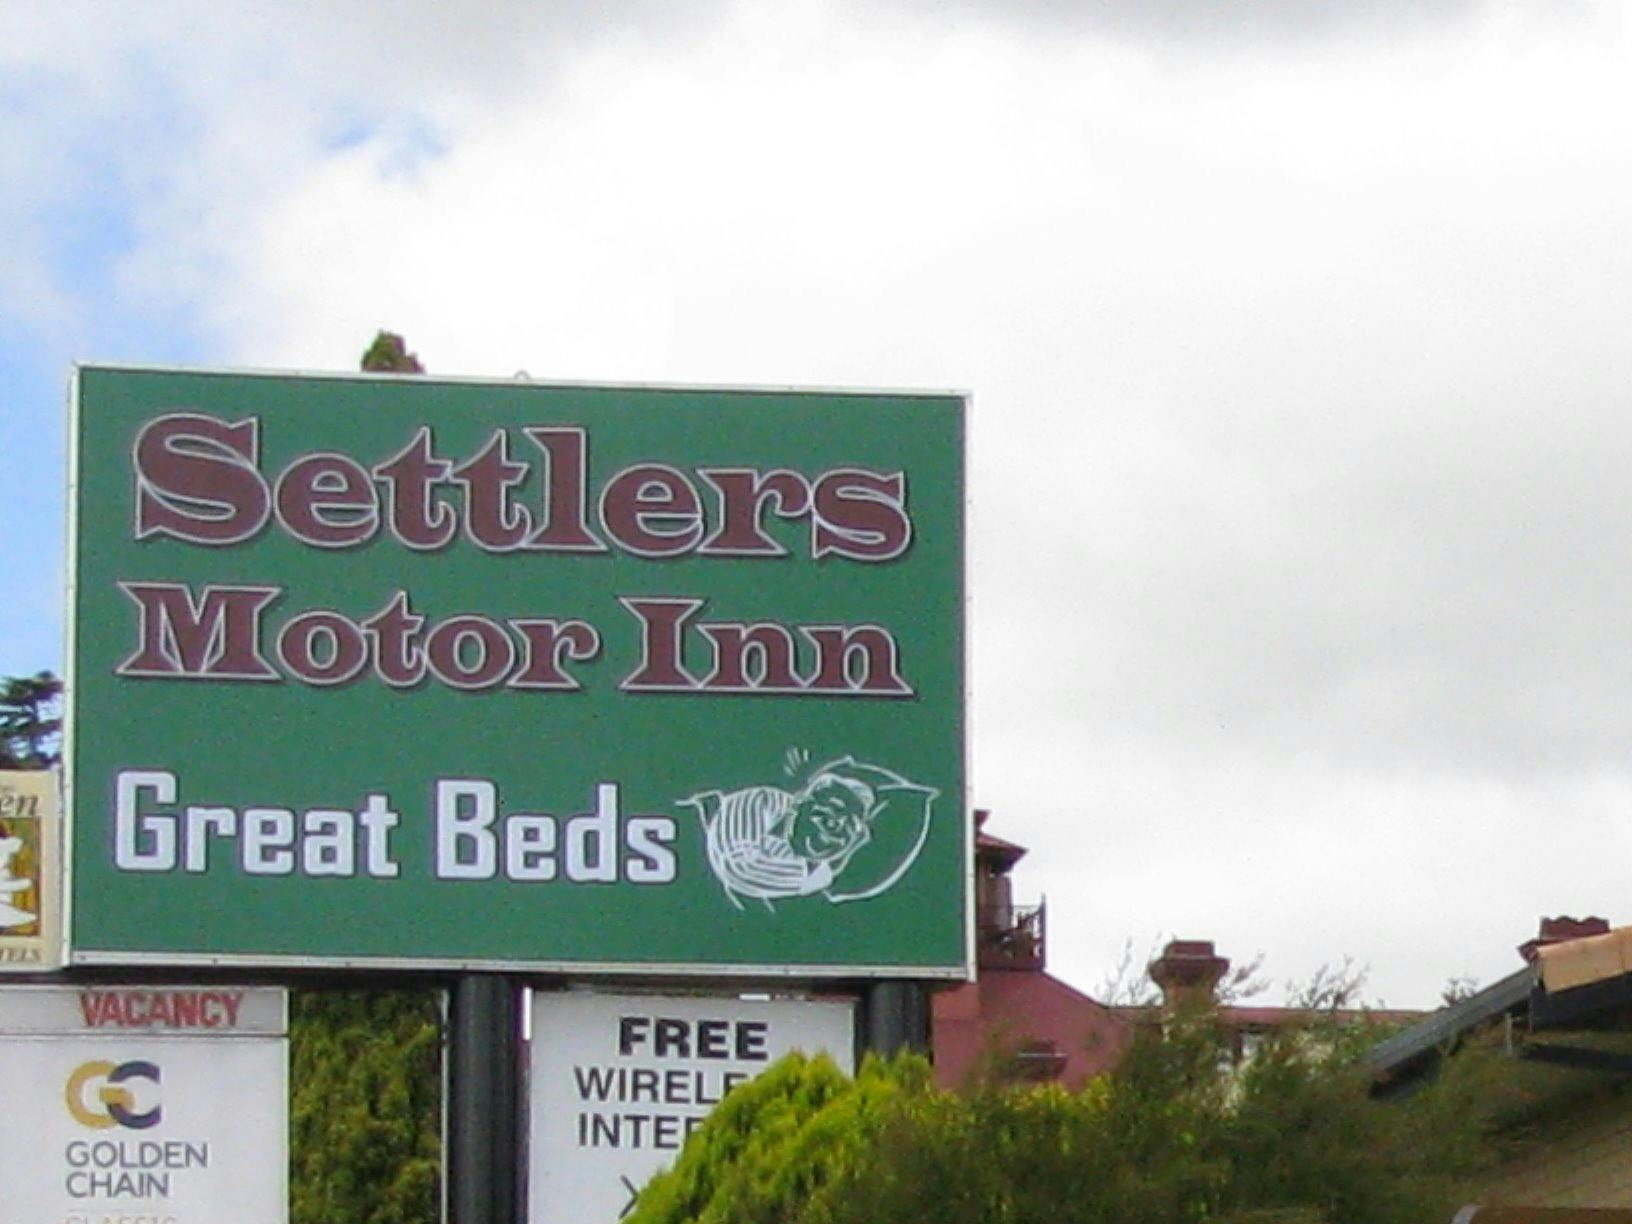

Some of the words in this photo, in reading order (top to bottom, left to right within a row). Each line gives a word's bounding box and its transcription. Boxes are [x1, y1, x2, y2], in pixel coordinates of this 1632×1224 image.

[133, 413, 914, 562] Settlers
[115, 581, 602, 692] Motor
[618, 596, 914, 696] Inn
[115, 770, 401, 878] Great
[436, 778, 677, 884] Beds
[80, 992, 246, 1028] VACANCY
[619, 1017, 769, 1061] FREE
[65, 1141, 208, 1168] GOLDEN
[65, 1171, 169, 1198] CHAIN
